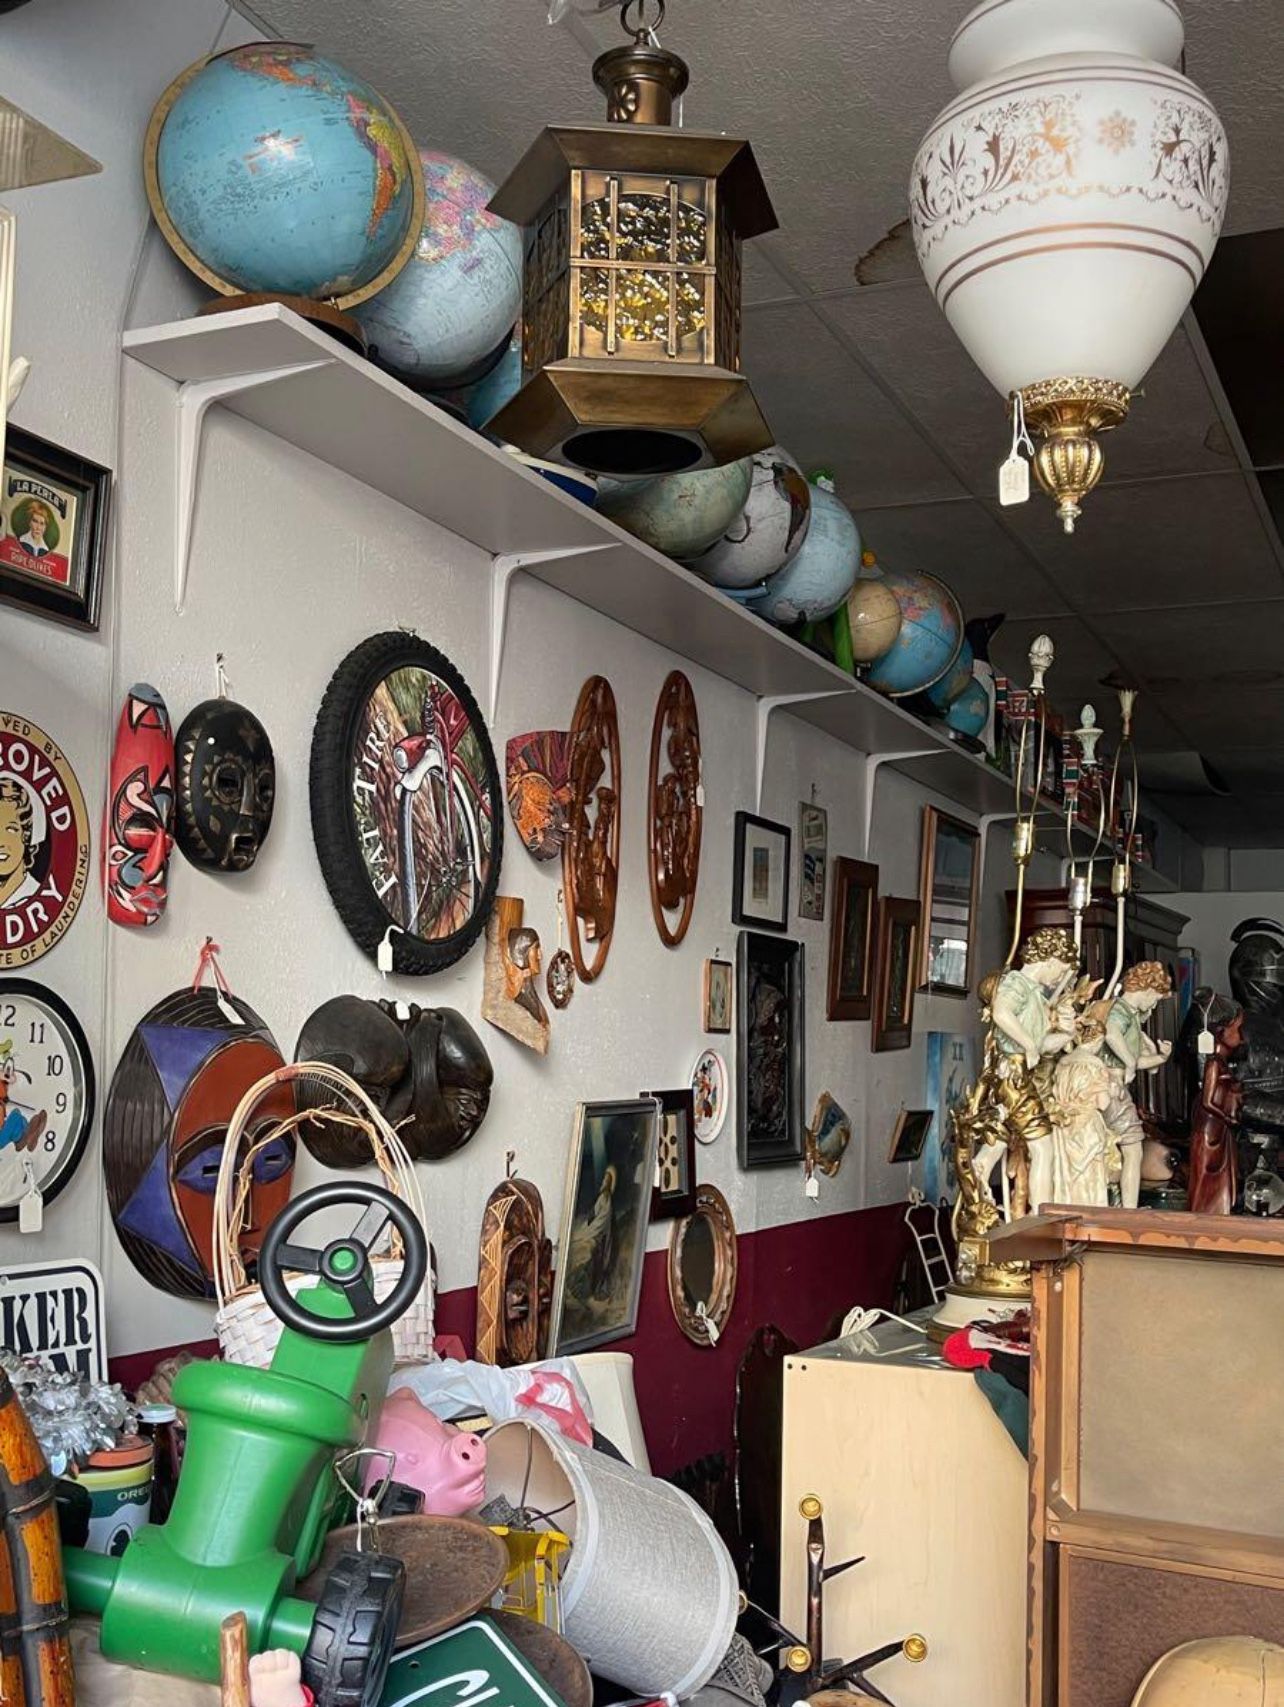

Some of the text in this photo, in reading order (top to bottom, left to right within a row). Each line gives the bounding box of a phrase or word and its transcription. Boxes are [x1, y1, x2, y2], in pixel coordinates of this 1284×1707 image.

[16, 481, 60, 508] LA PERLA
[43, 741, 62, 761] BY
[0, 740, 71, 832] OVED
[5, 873, 64, 944] DRY
[20, 944, 37, 961] OF
[43, 844, 88, 948] LAUNDERING
[29, 1022, 45, 1044] 11
[46, 1055, 64, 1077] 10
[55, 1092, 67, 1114] 9
[44, 1131, 56, 1152] 8
[0, 1286, 92, 1355] KER
